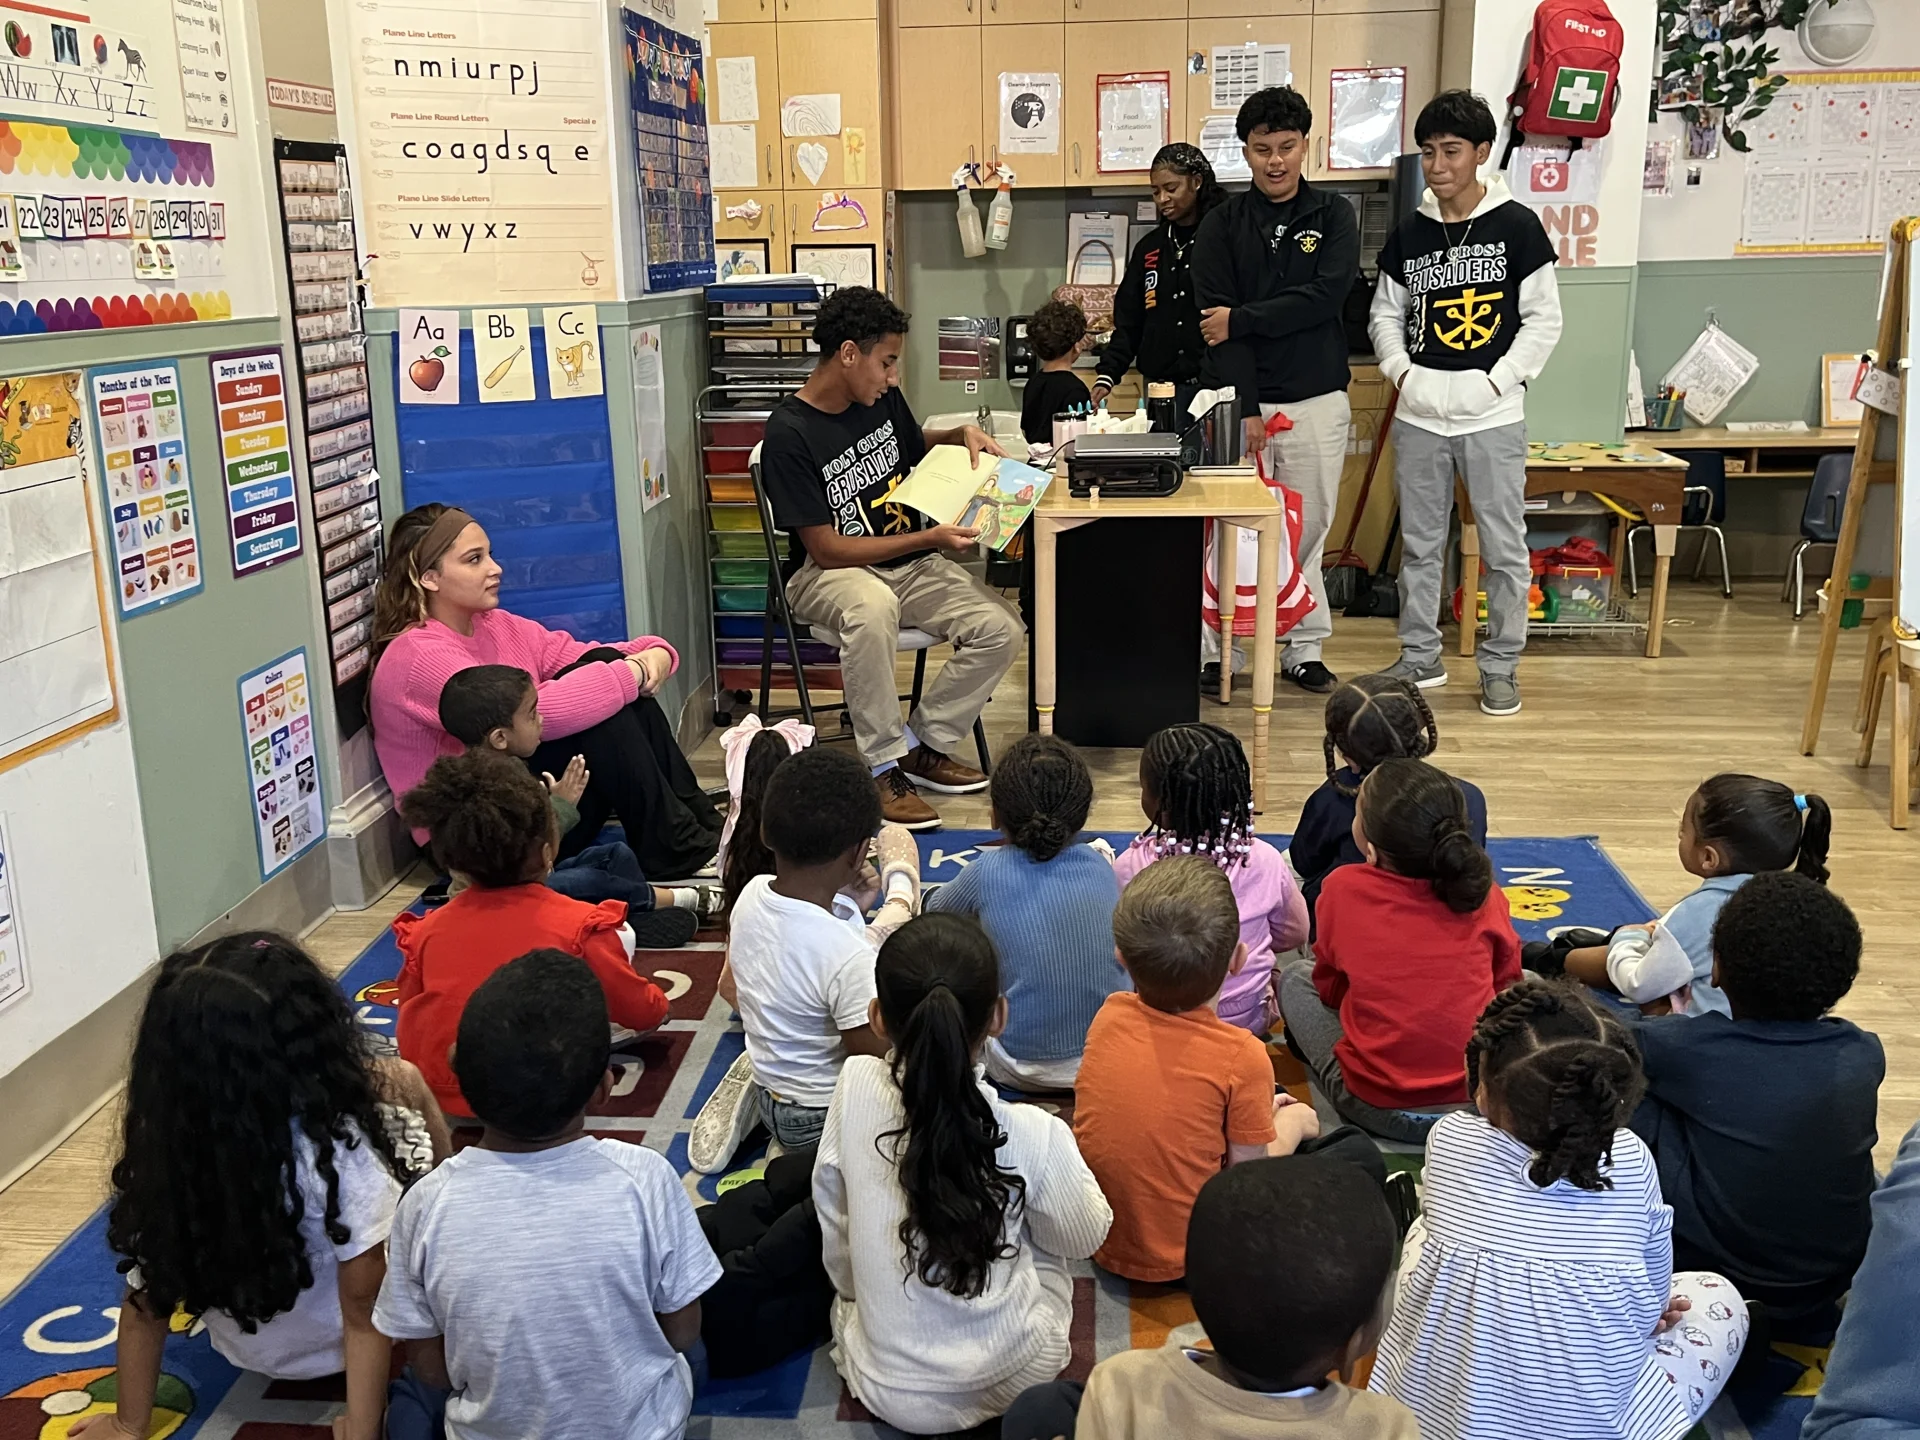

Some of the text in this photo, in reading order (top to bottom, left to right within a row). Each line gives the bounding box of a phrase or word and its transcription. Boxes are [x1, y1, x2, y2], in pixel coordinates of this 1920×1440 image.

[383, 29, 457, 40] Plane Line Letters
[1565, 18, 1607, 38] FIRST AID
[390, 113, 414, 121] Plane
[415, 113, 433, 121] Line
[434, 114, 460, 122] Round
[563, 117, 591, 125] Special
[19, 208, 40, 229] 22
[43, 206, 60, 229] 23
[66, 208, 83, 229] 24
[89, 206, 104, 227] 25
[111, 208, 127, 228] 26
[134, 209, 146, 229] 27
[153, 210, 167, 229] 28
[172, 211, 188, 229] 29
[192, 210, 206, 229] 30
[211, 211, 221, 229] 31
[1403, 242, 1506, 273] HOLY CROSS
[413, 315, 444, 339] Aa
[488, 314, 515, 339] Bb
[558, 312, 584, 335] Cc
[220, 360, 274, 378] Days of the Week
[100, 374, 171, 393] Months of the Year
[235, 382, 262, 396] Sunday
[238, 409, 266, 423] Monday
[240, 435, 270, 450] Tuesday
[238, 460, 278, 478] Wednesday
[822, 446, 857, 481] HOLY
[244, 486, 278, 503] Thursday
[251, 512, 276, 528] Friday
[250, 537, 283, 556] Saturday
[265, 670, 282, 684] Colors
